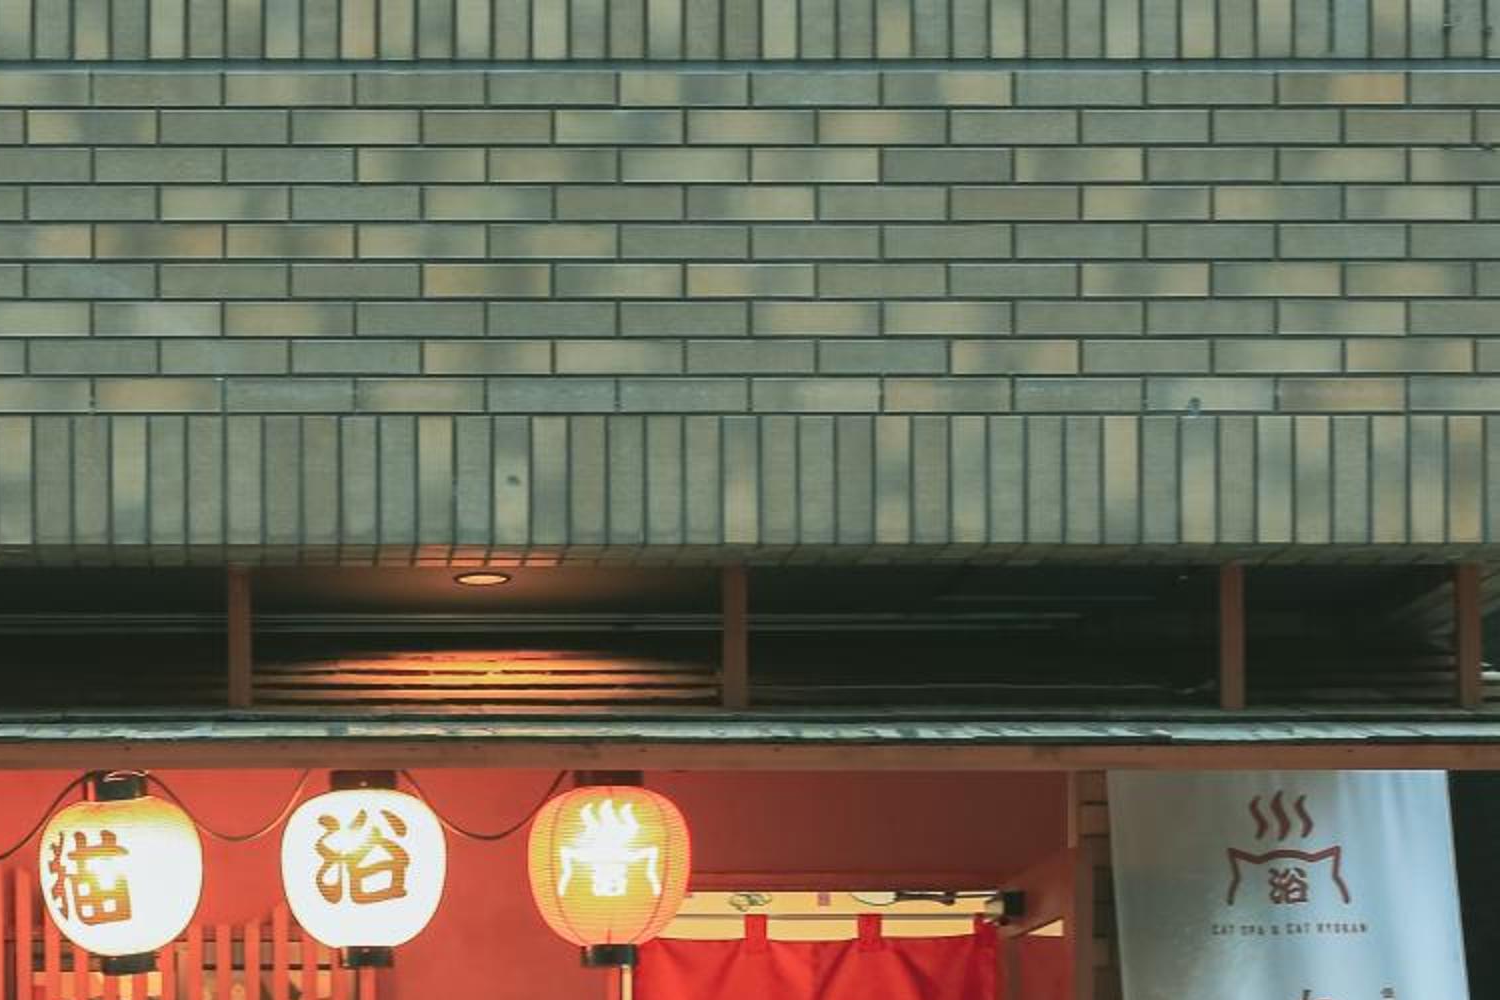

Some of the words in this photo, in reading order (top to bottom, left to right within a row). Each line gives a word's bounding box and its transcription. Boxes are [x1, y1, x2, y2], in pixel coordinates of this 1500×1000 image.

[47, 828, 132, 926] 猫
[315, 808, 414, 906] 浴
[1269, 867, 1308, 904] 浴
